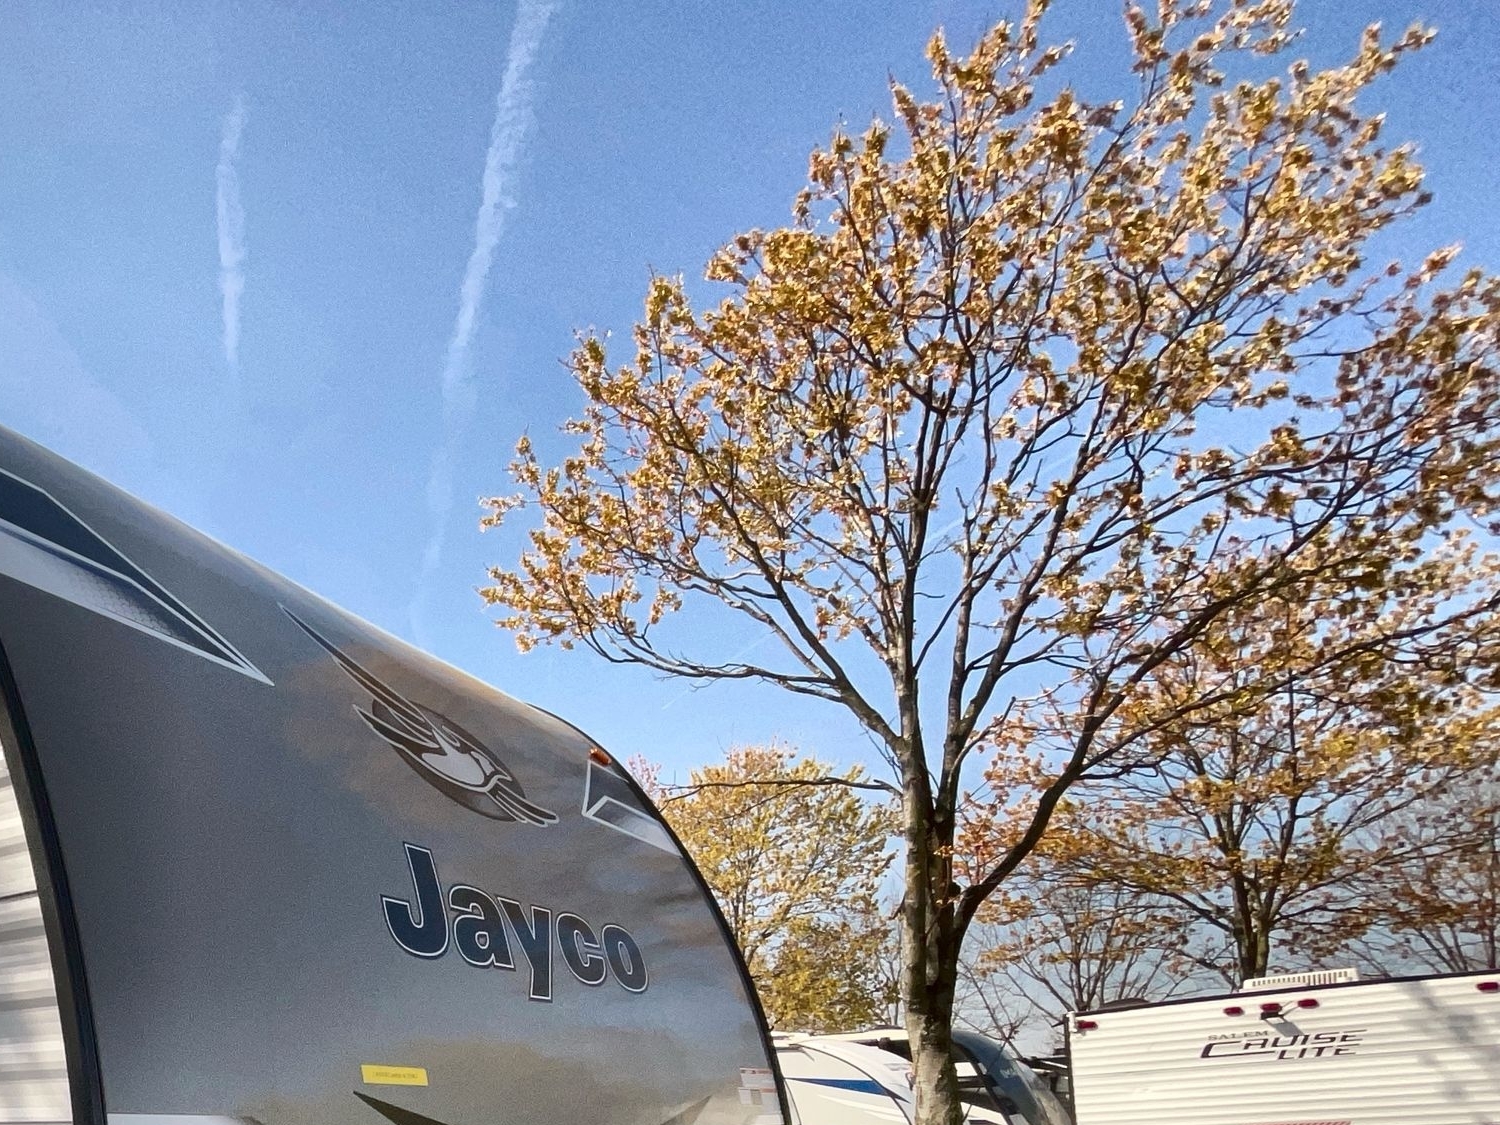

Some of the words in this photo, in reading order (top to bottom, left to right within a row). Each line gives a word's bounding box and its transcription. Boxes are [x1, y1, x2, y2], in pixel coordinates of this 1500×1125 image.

[380, 841, 649, 1002] Jayco
[1200, 1029, 1368, 1059] CRUISE
[1207, 1030, 1269, 1041] SALEM
[1277, 1043, 1360, 1060] LITE
